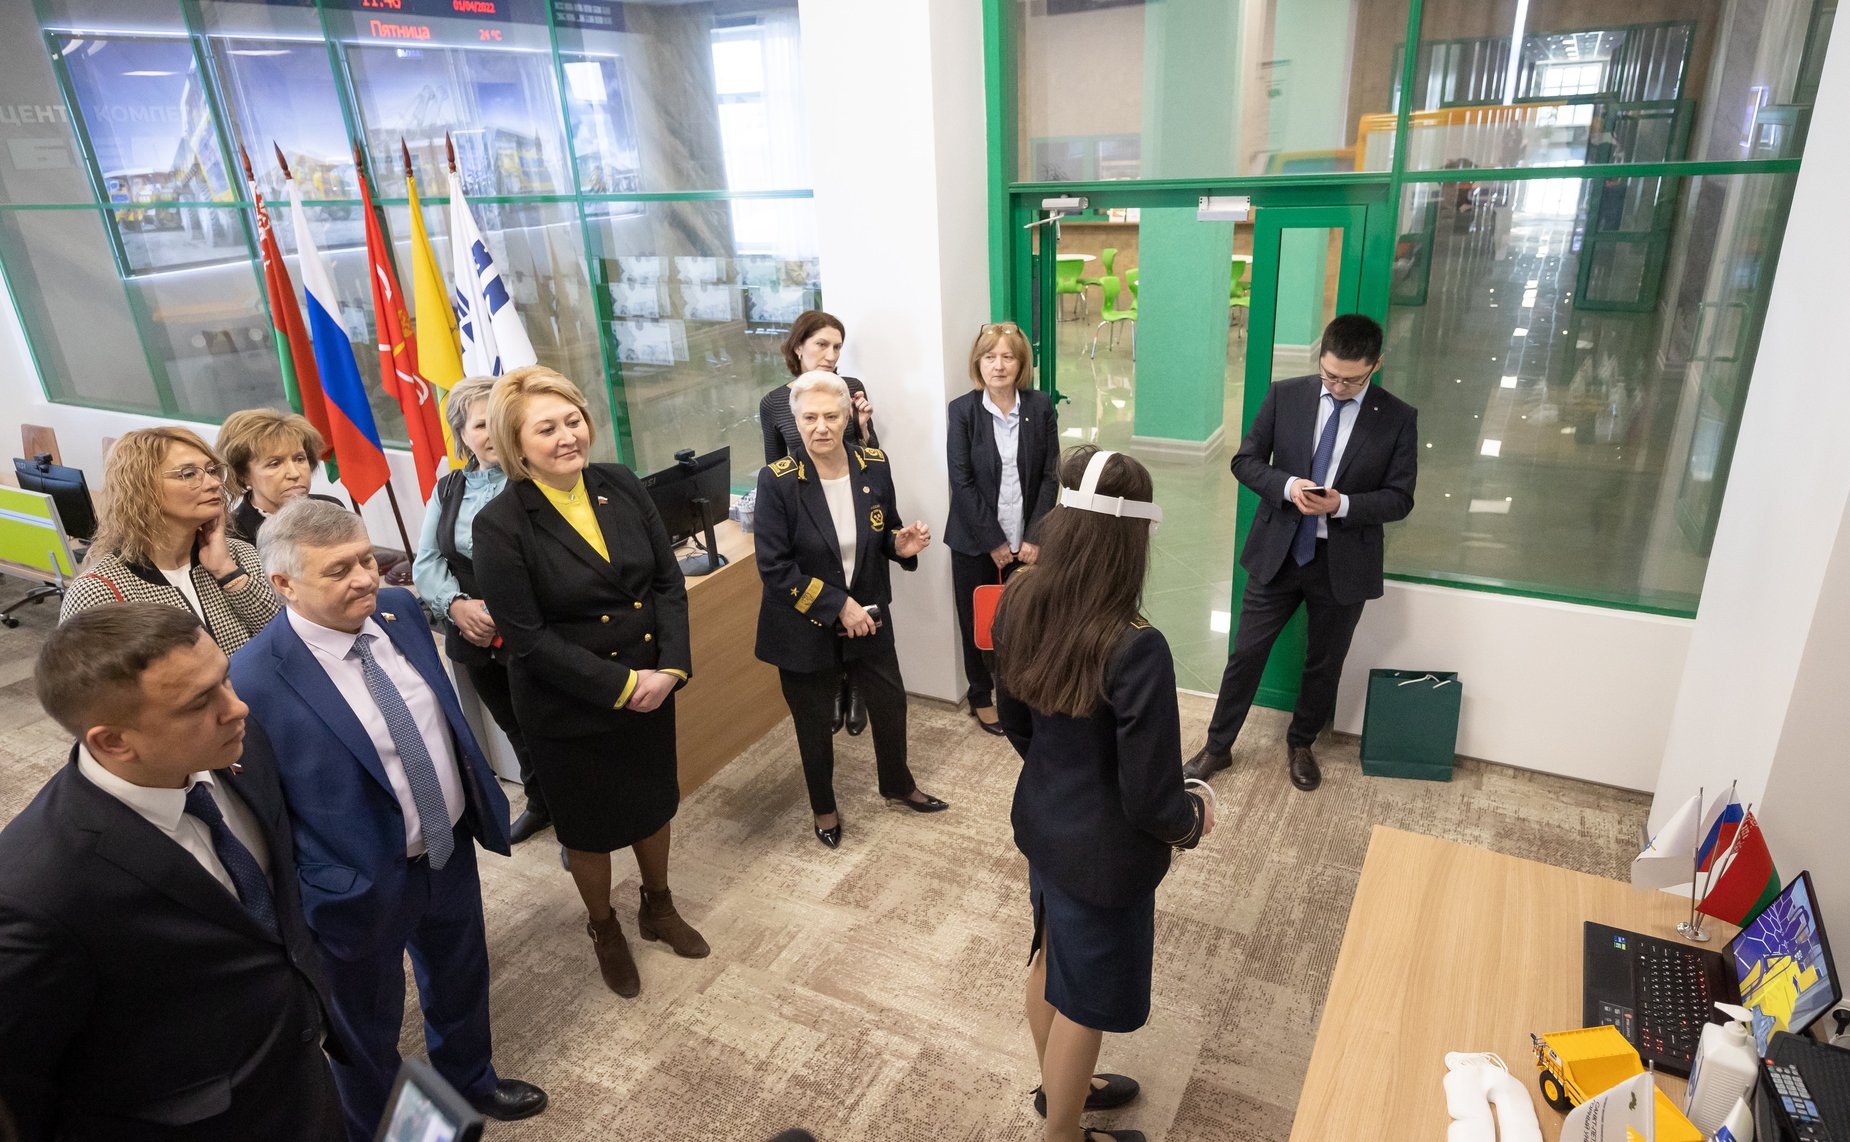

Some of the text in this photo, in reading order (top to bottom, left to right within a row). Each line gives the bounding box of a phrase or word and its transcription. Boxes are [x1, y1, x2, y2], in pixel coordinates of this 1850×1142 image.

[369, 20, 431, 41] Пятница
[0, 105, 179, 127] ЦЕНТ КОМПЕ
[1590, 1101, 1600, 1142] САНКТ-ПЕТ
